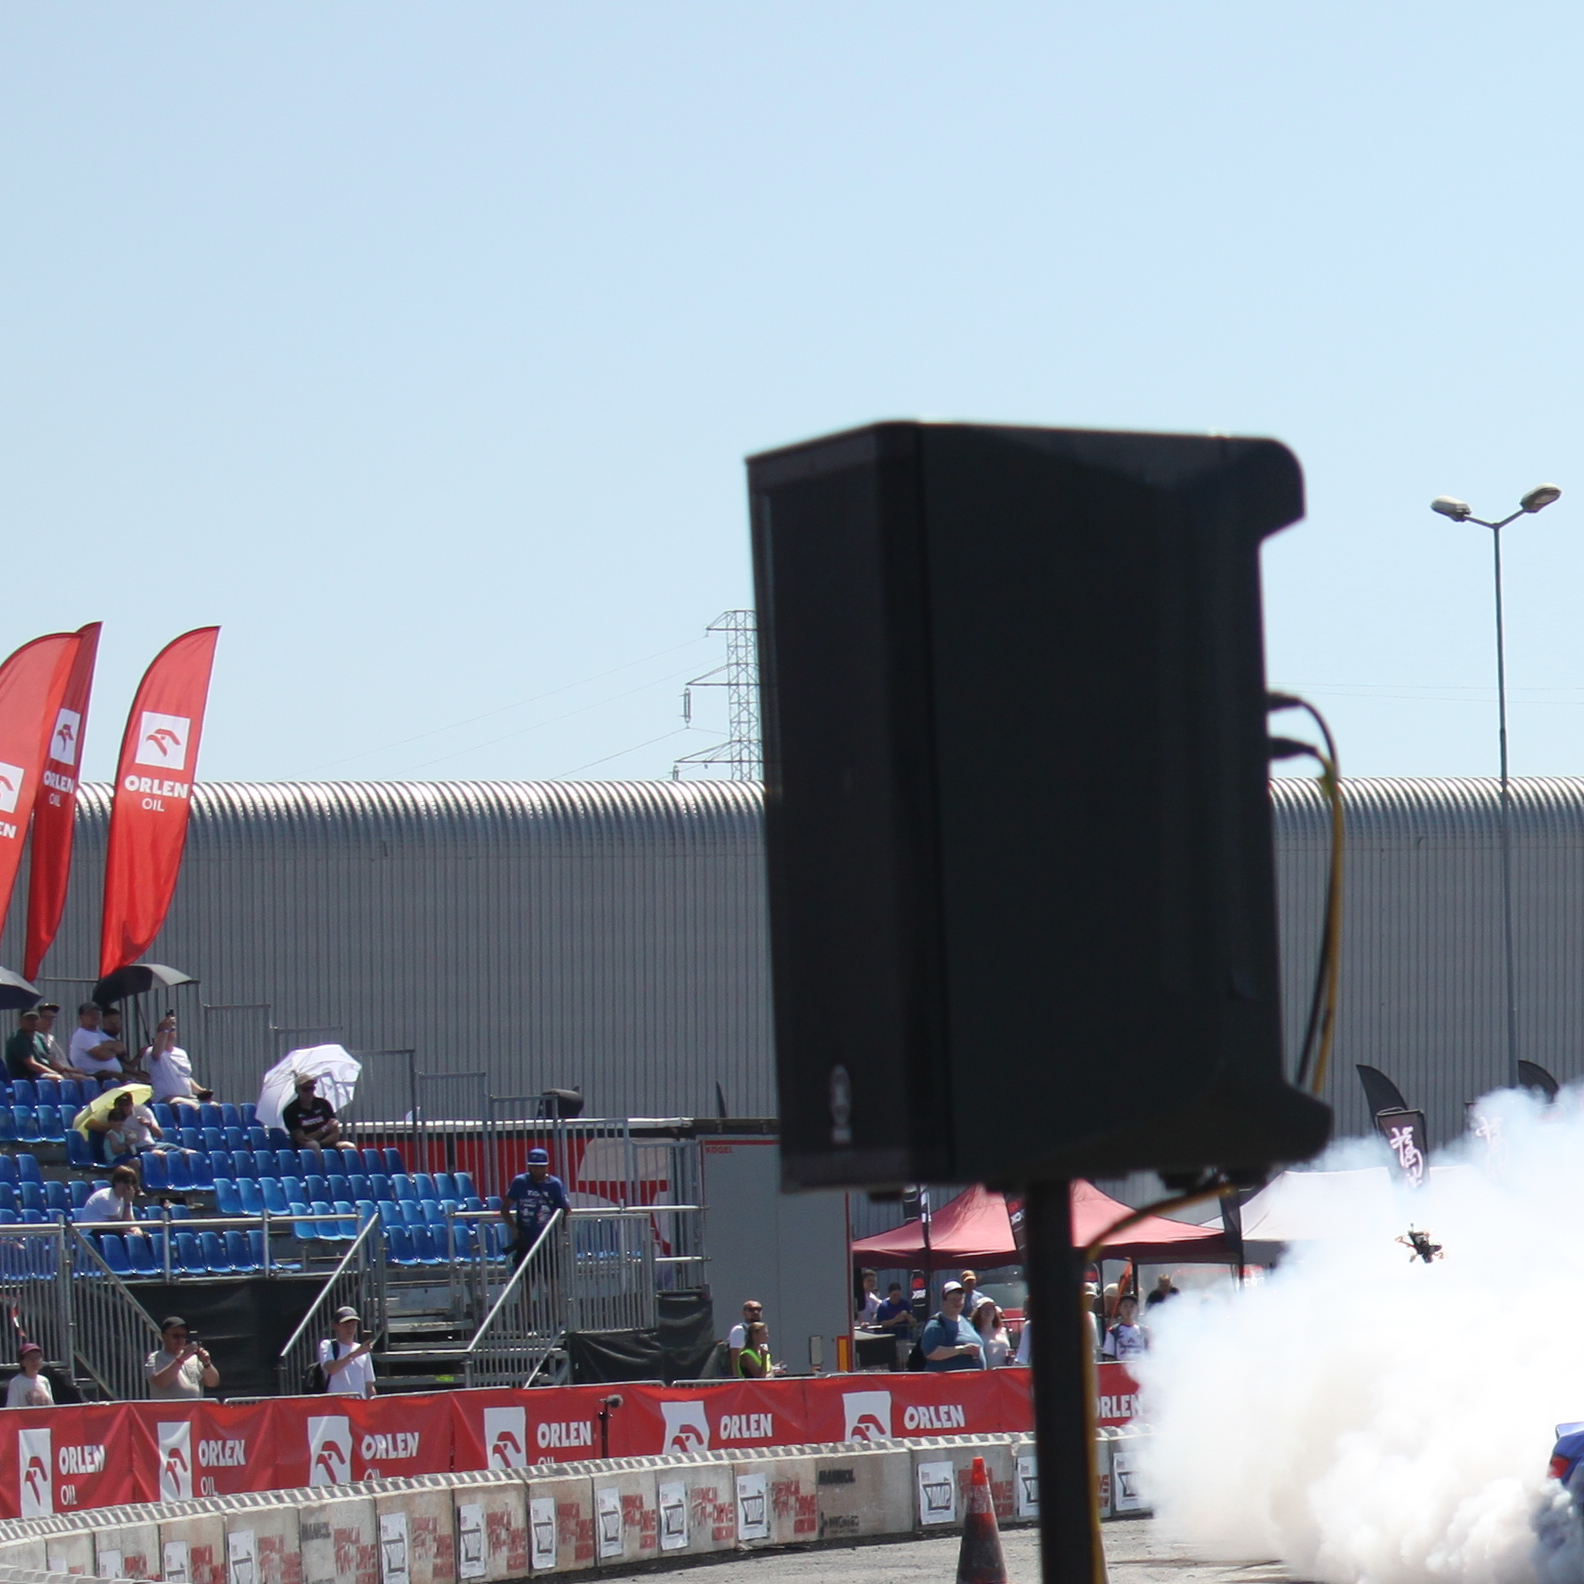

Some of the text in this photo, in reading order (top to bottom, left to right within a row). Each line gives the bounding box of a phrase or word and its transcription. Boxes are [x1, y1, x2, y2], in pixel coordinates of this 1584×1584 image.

[43, 771, 75, 794] ORLEN
[124, 775, 190, 799] ORLEN
[49, 793, 61, 808] OIL
[141, 797, 165, 812] OIL
[719, 1413, 773, 1440] ORLEN
[904, 1404, 965, 1430] ORLEN
[361, 1431, 420, 1460] ORLEN
[537, 1420, 592, 1449] ORLEN
[60, 1444, 105, 1474] ORLEN
[199, 1438, 246, 1468] ORLEN
[61, 1484, 78, 1506] OIL
